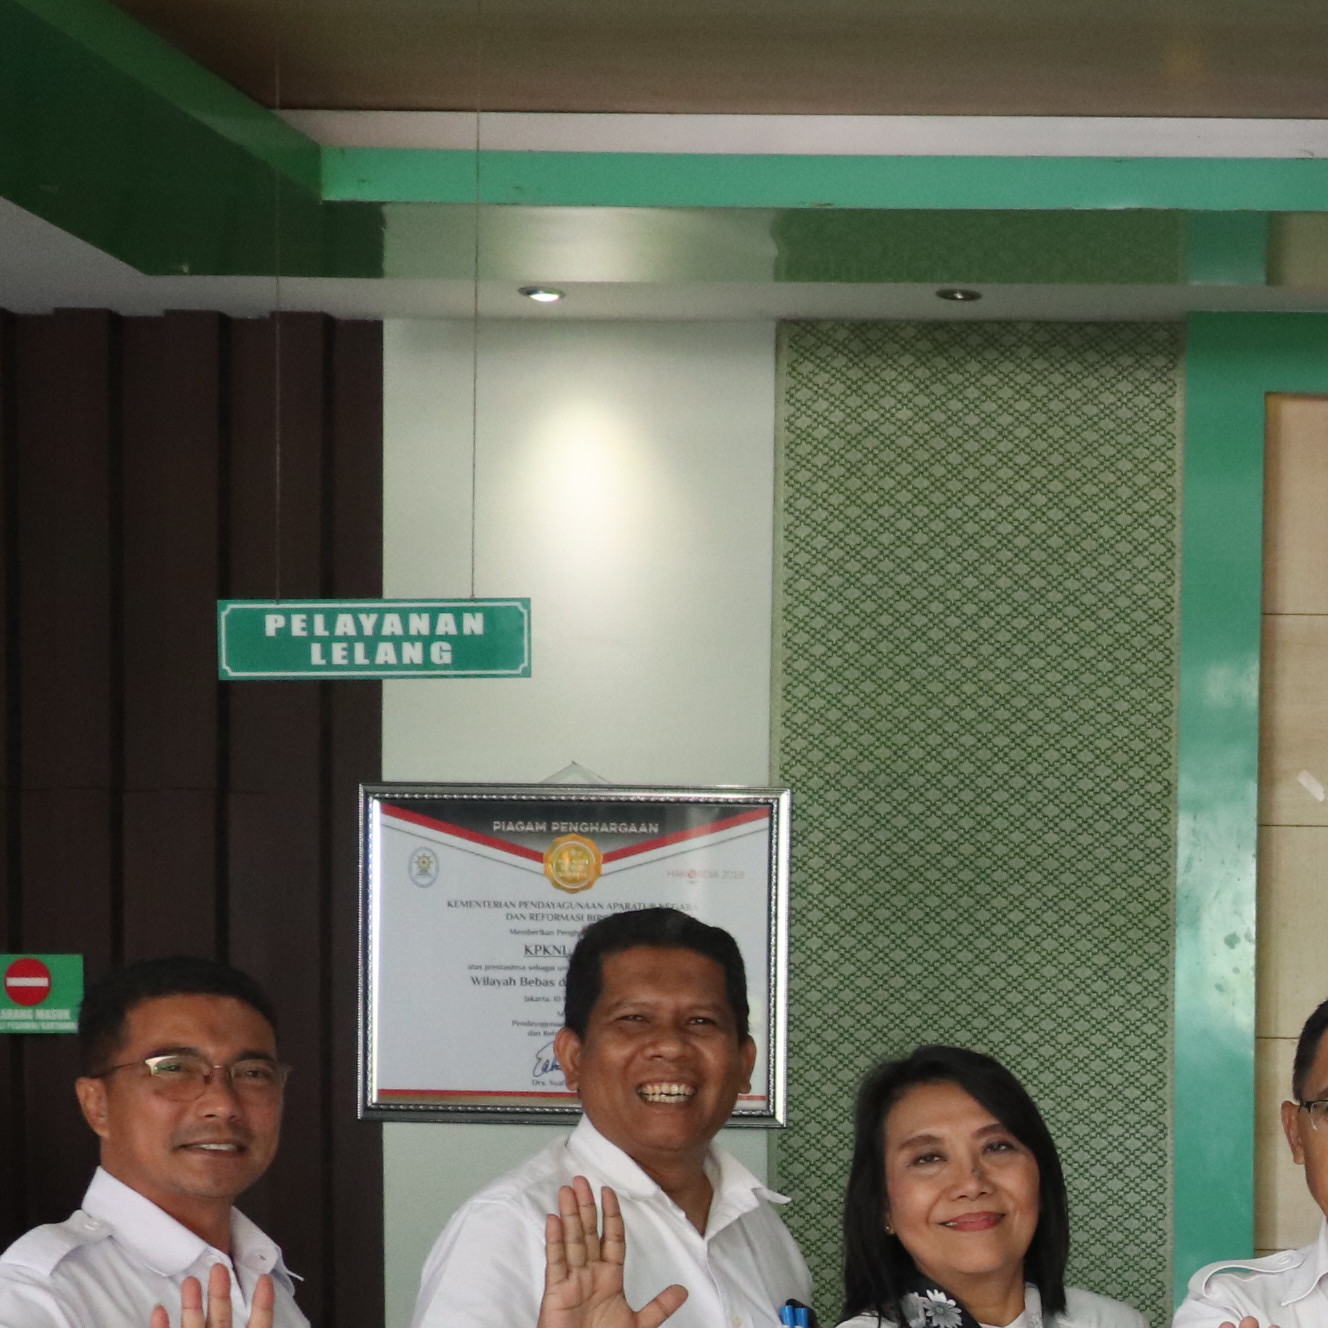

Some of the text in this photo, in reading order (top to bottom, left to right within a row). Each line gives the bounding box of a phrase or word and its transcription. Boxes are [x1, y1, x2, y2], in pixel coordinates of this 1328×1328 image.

[264, 612, 485, 637] PELAYANAN
[310, 641, 453, 666] LELANG
[493, 820, 660, 834] PIAGAM PENGHARGAAN
[447, 900, 515, 909] KEMENTERIAN
[506, 912, 526, 921] DAN
[529, 913, 584, 922] REFORMASI
[471, 976, 516, 988] Wilayah
[519, 976, 555, 987] Bebas
